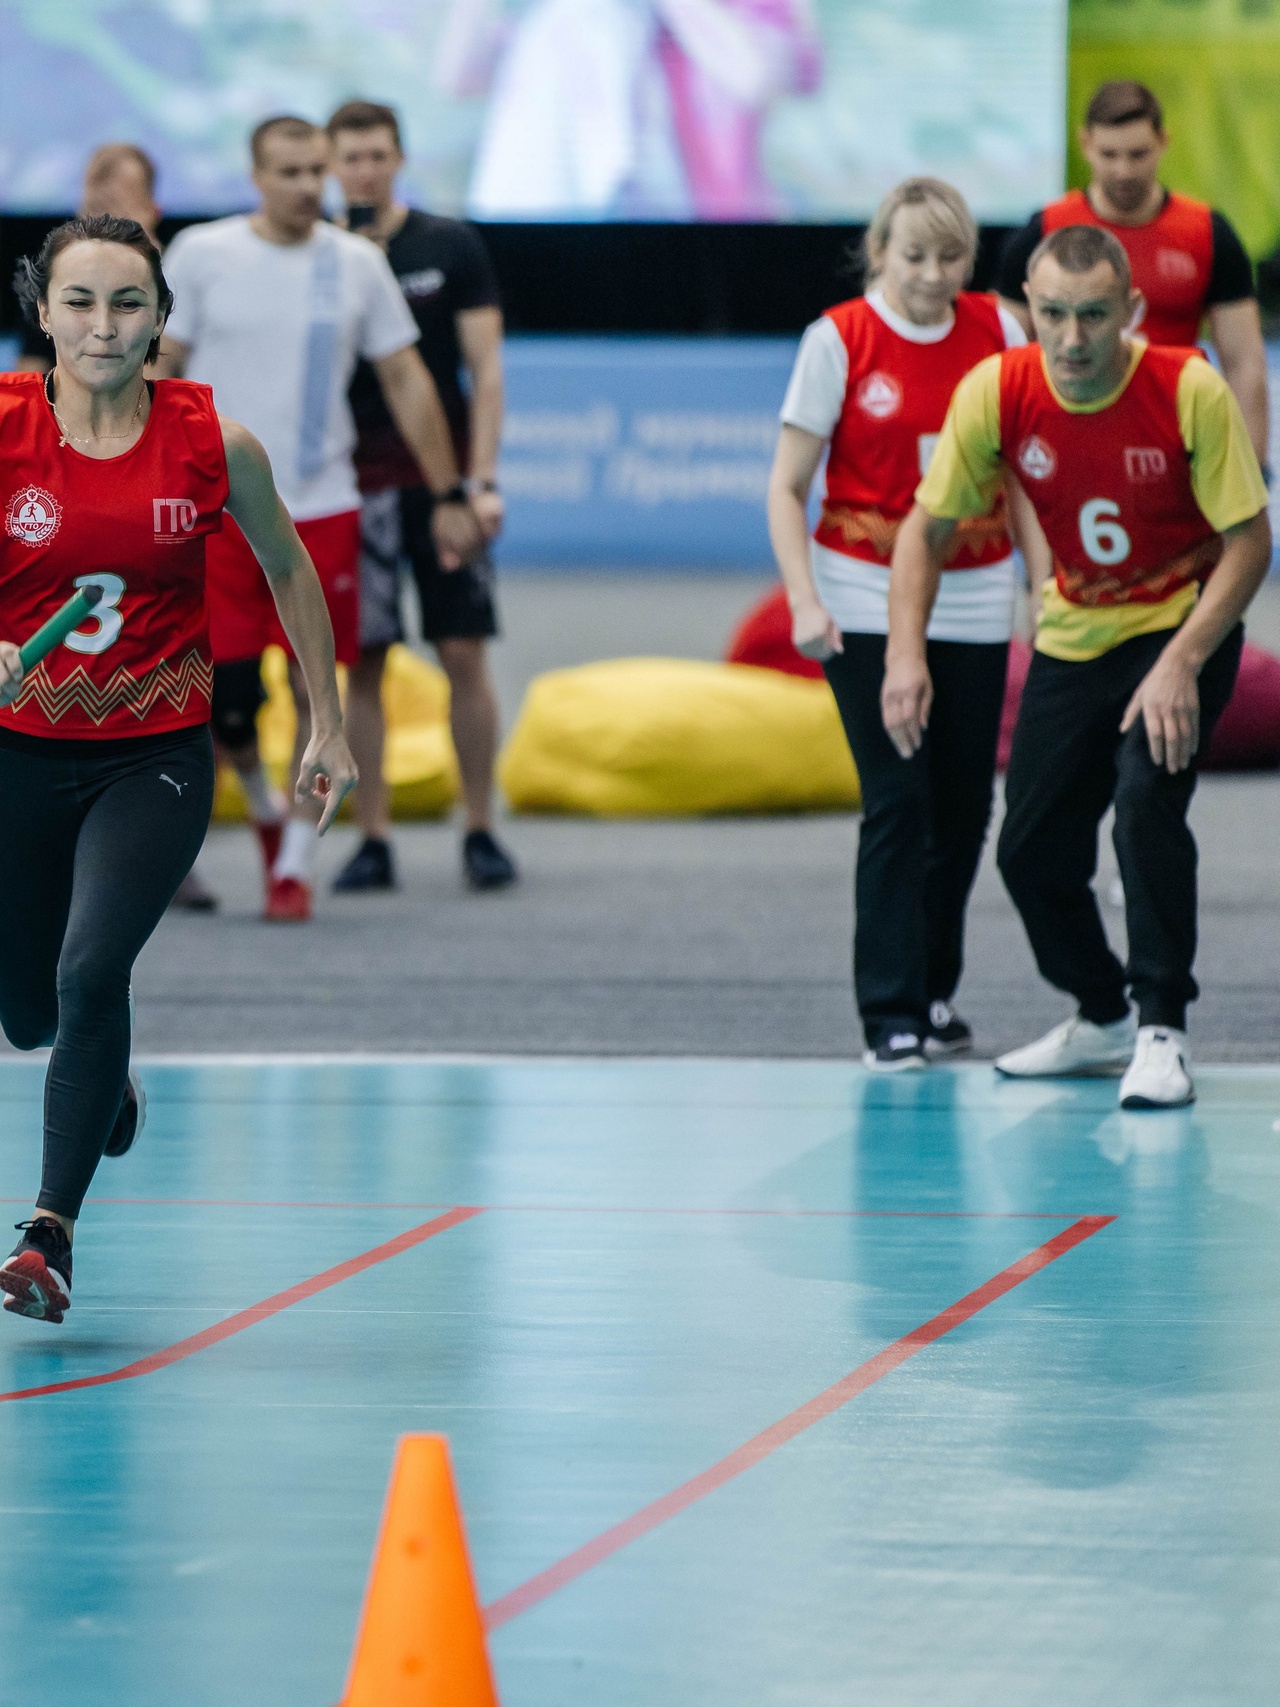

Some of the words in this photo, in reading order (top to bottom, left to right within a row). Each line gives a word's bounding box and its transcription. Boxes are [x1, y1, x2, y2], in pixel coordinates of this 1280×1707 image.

[1124, 446, 1167, 480] ГТО
[152, 498, 198, 532] ГТО
[1079, 498, 1131, 565] 6
[63, 572, 127, 655] 3
